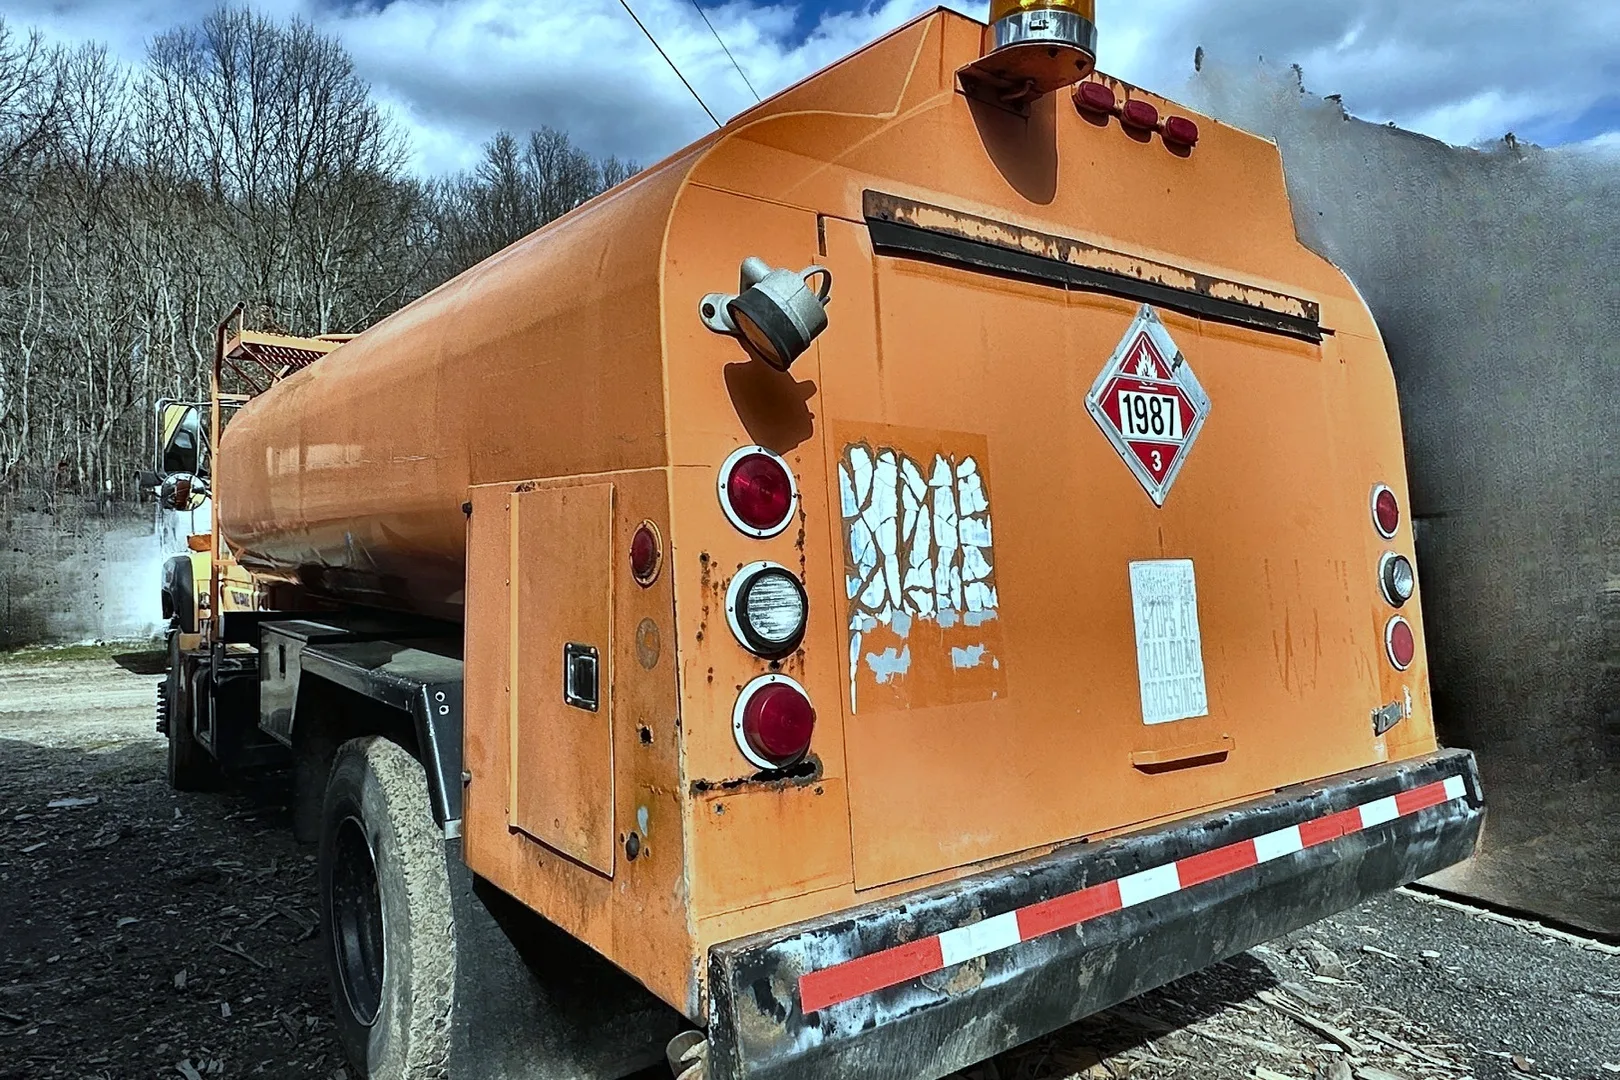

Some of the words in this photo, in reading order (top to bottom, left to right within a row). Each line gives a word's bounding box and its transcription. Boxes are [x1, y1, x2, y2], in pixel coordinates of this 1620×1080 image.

[1122, 393, 1174, 436] 1987
[1151, 450, 1162, 471] 3
[1142, 602, 1176, 638] STOPS
[1180, 600, 1193, 637] AT
[1143, 641, 1199, 678] RAILROAD
[1144, 677, 1203, 717] CROSSINGS
